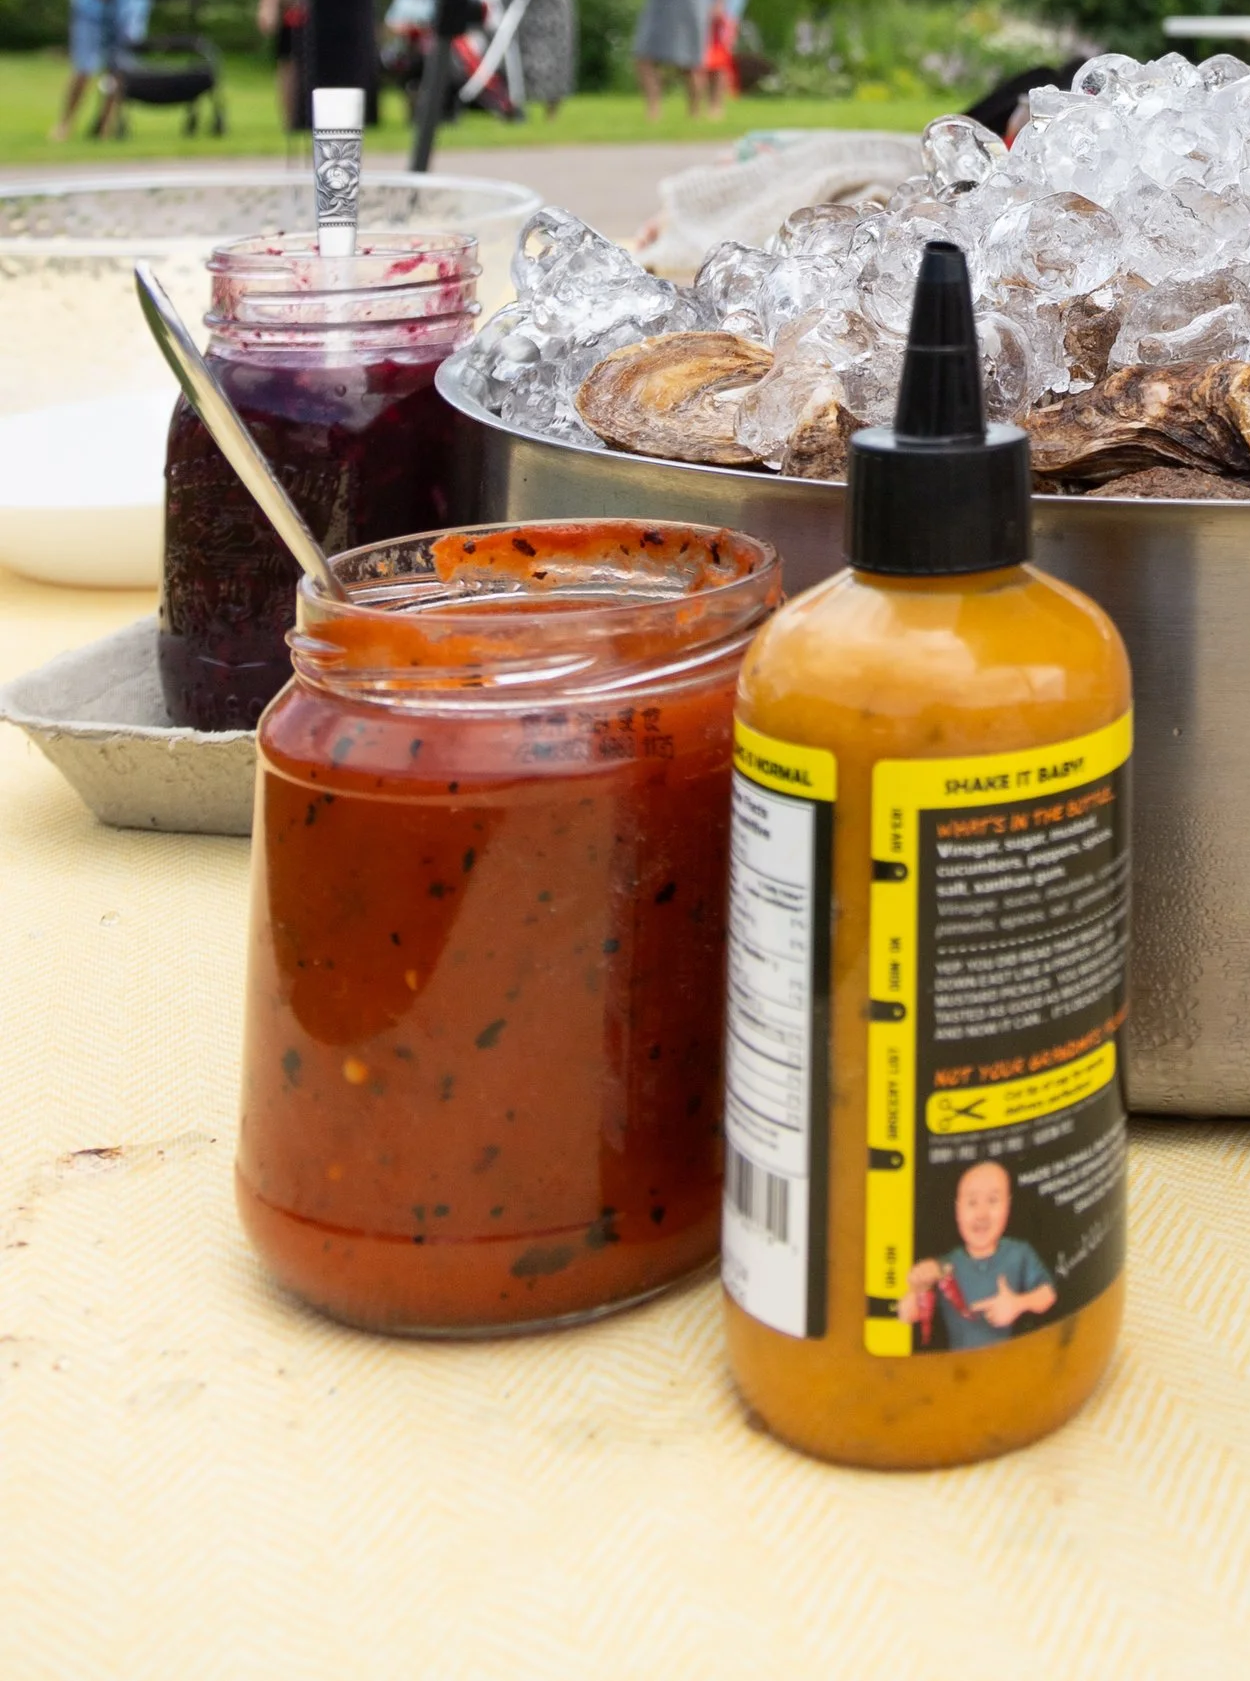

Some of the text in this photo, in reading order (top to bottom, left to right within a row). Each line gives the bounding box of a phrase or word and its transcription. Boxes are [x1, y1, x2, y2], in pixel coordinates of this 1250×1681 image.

[945, 774, 1009, 795] SHAKE
[1016, 770, 1031, 786] IT
[936, 815, 1006, 838] WHAT'S
[1009, 812, 1029, 832] IN
[1032, 804, 1064, 825] THE
[936, 840, 1001, 858] Vinegar,
[1004, 831, 1046, 852] sugar,
[936, 856, 1025, 877] cucumbers,
[936, 865, 1066, 897] salt, xanthan gum.
[934, 976, 977, 992] DOWN
[934, 989, 998, 1009] MUSTARD
[934, 1009, 986, 1024] TASTED
[934, 1026, 964, 1041] AND
[965, 1021, 998, 1036] NOW
[933, 1065, 973, 1087] NOT
[977, 1056, 1026, 1081] YOUR
